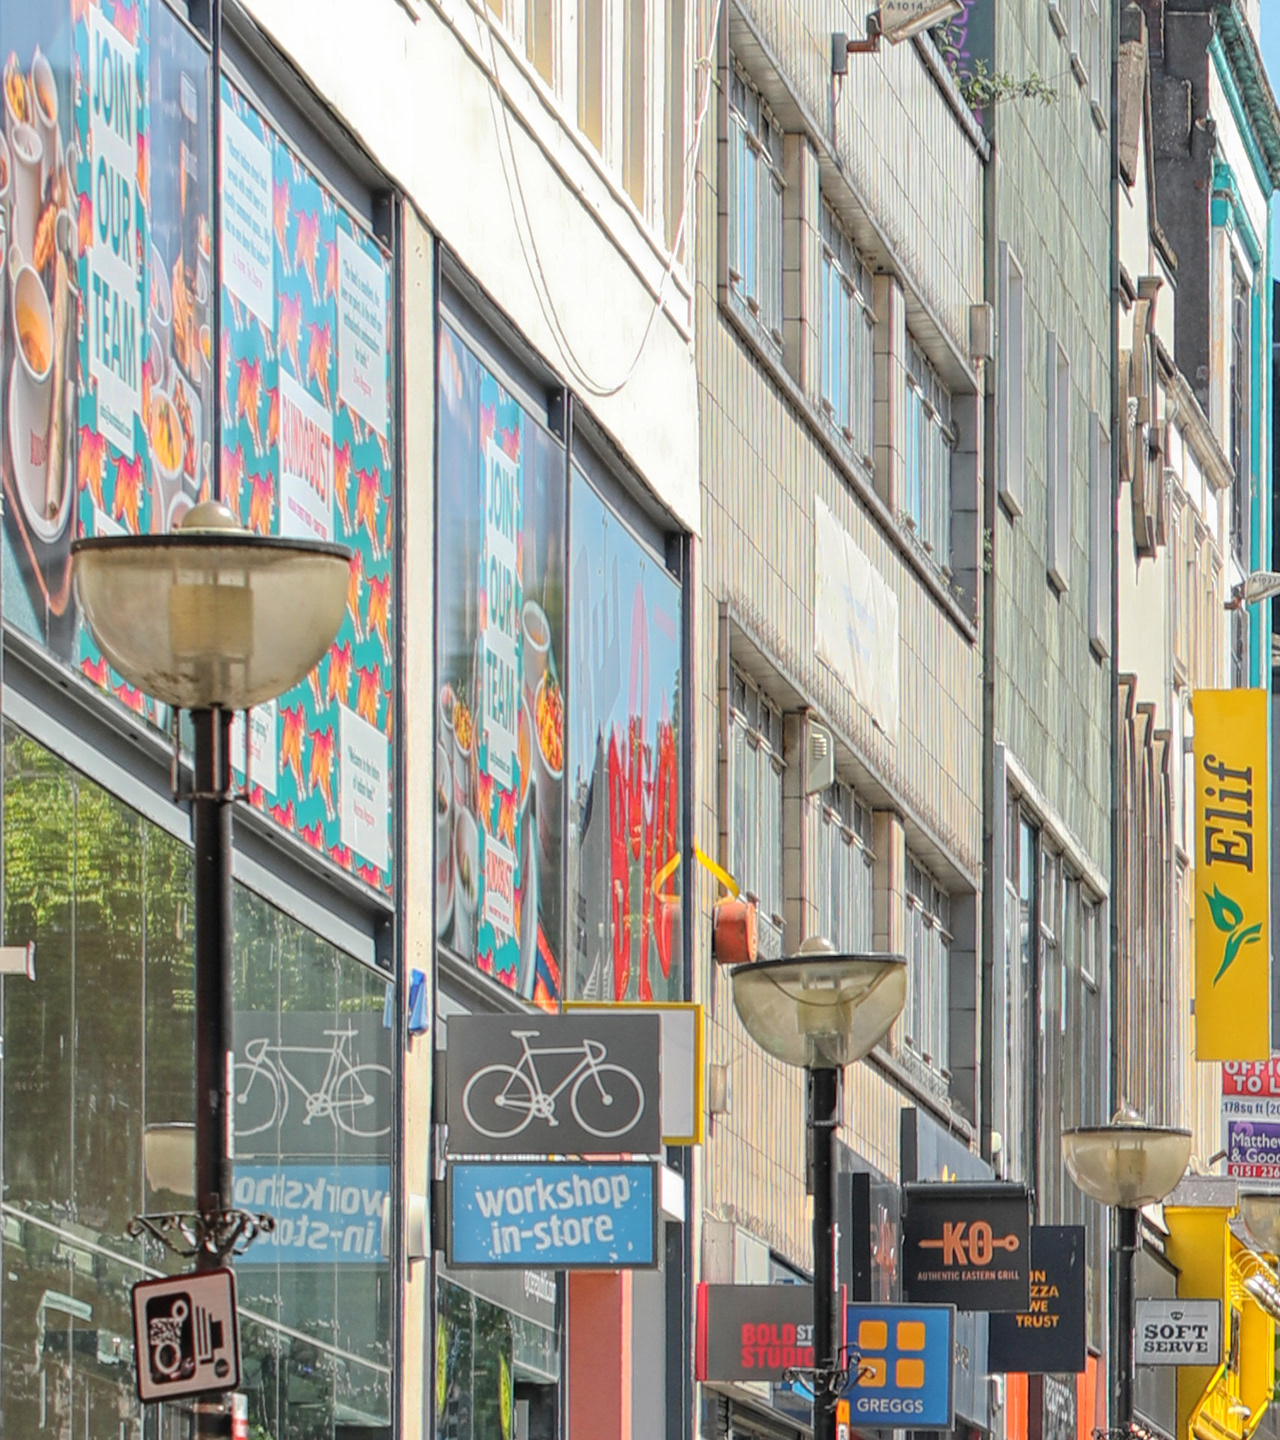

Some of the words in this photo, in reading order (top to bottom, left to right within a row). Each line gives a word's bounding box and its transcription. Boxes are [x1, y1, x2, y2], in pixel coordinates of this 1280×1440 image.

[887, 2, 923, 10] A1014
[93, 29, 133, 148] JOIN
[99, 155, 131, 267] OUR
[93, 270, 136, 392] TEAM
[487, 456, 515, 539] JOIN
[488, 553, 514, 638] OUR
[487, 652, 516, 738] TEAM
[1203, 753, 1253, 874] Elif
[1233, 1075, 1261, 1092] TO
[1255, 1102, 1263, 1113] ft
[1231, 1148, 1242, 1161] &
[1232, 1166, 1256, 1177] 0151
[1261, 1166, 1280, 1177] 236
[476, 1174, 630, 1218] workshop
[491, 1214, 614, 1253] in-store
[943, 1221, 993, 1266] KO
[918, 1271, 959, 1281] AUTHENTIC
[962, 1270, 995, 1281] EASTERN
[997, 1270, 1019, 1280] GRILL
[1030, 1285, 1059, 1298] ZZA
[1016, 1315, 1059, 1328] TRUST
[741, 1323, 795, 1345] BOLD
[1144, 1324, 1208, 1340] SOFT
[1143, 1341, 1208, 1353] SERVE
[857, 1398, 923, 1413] GREGGS
